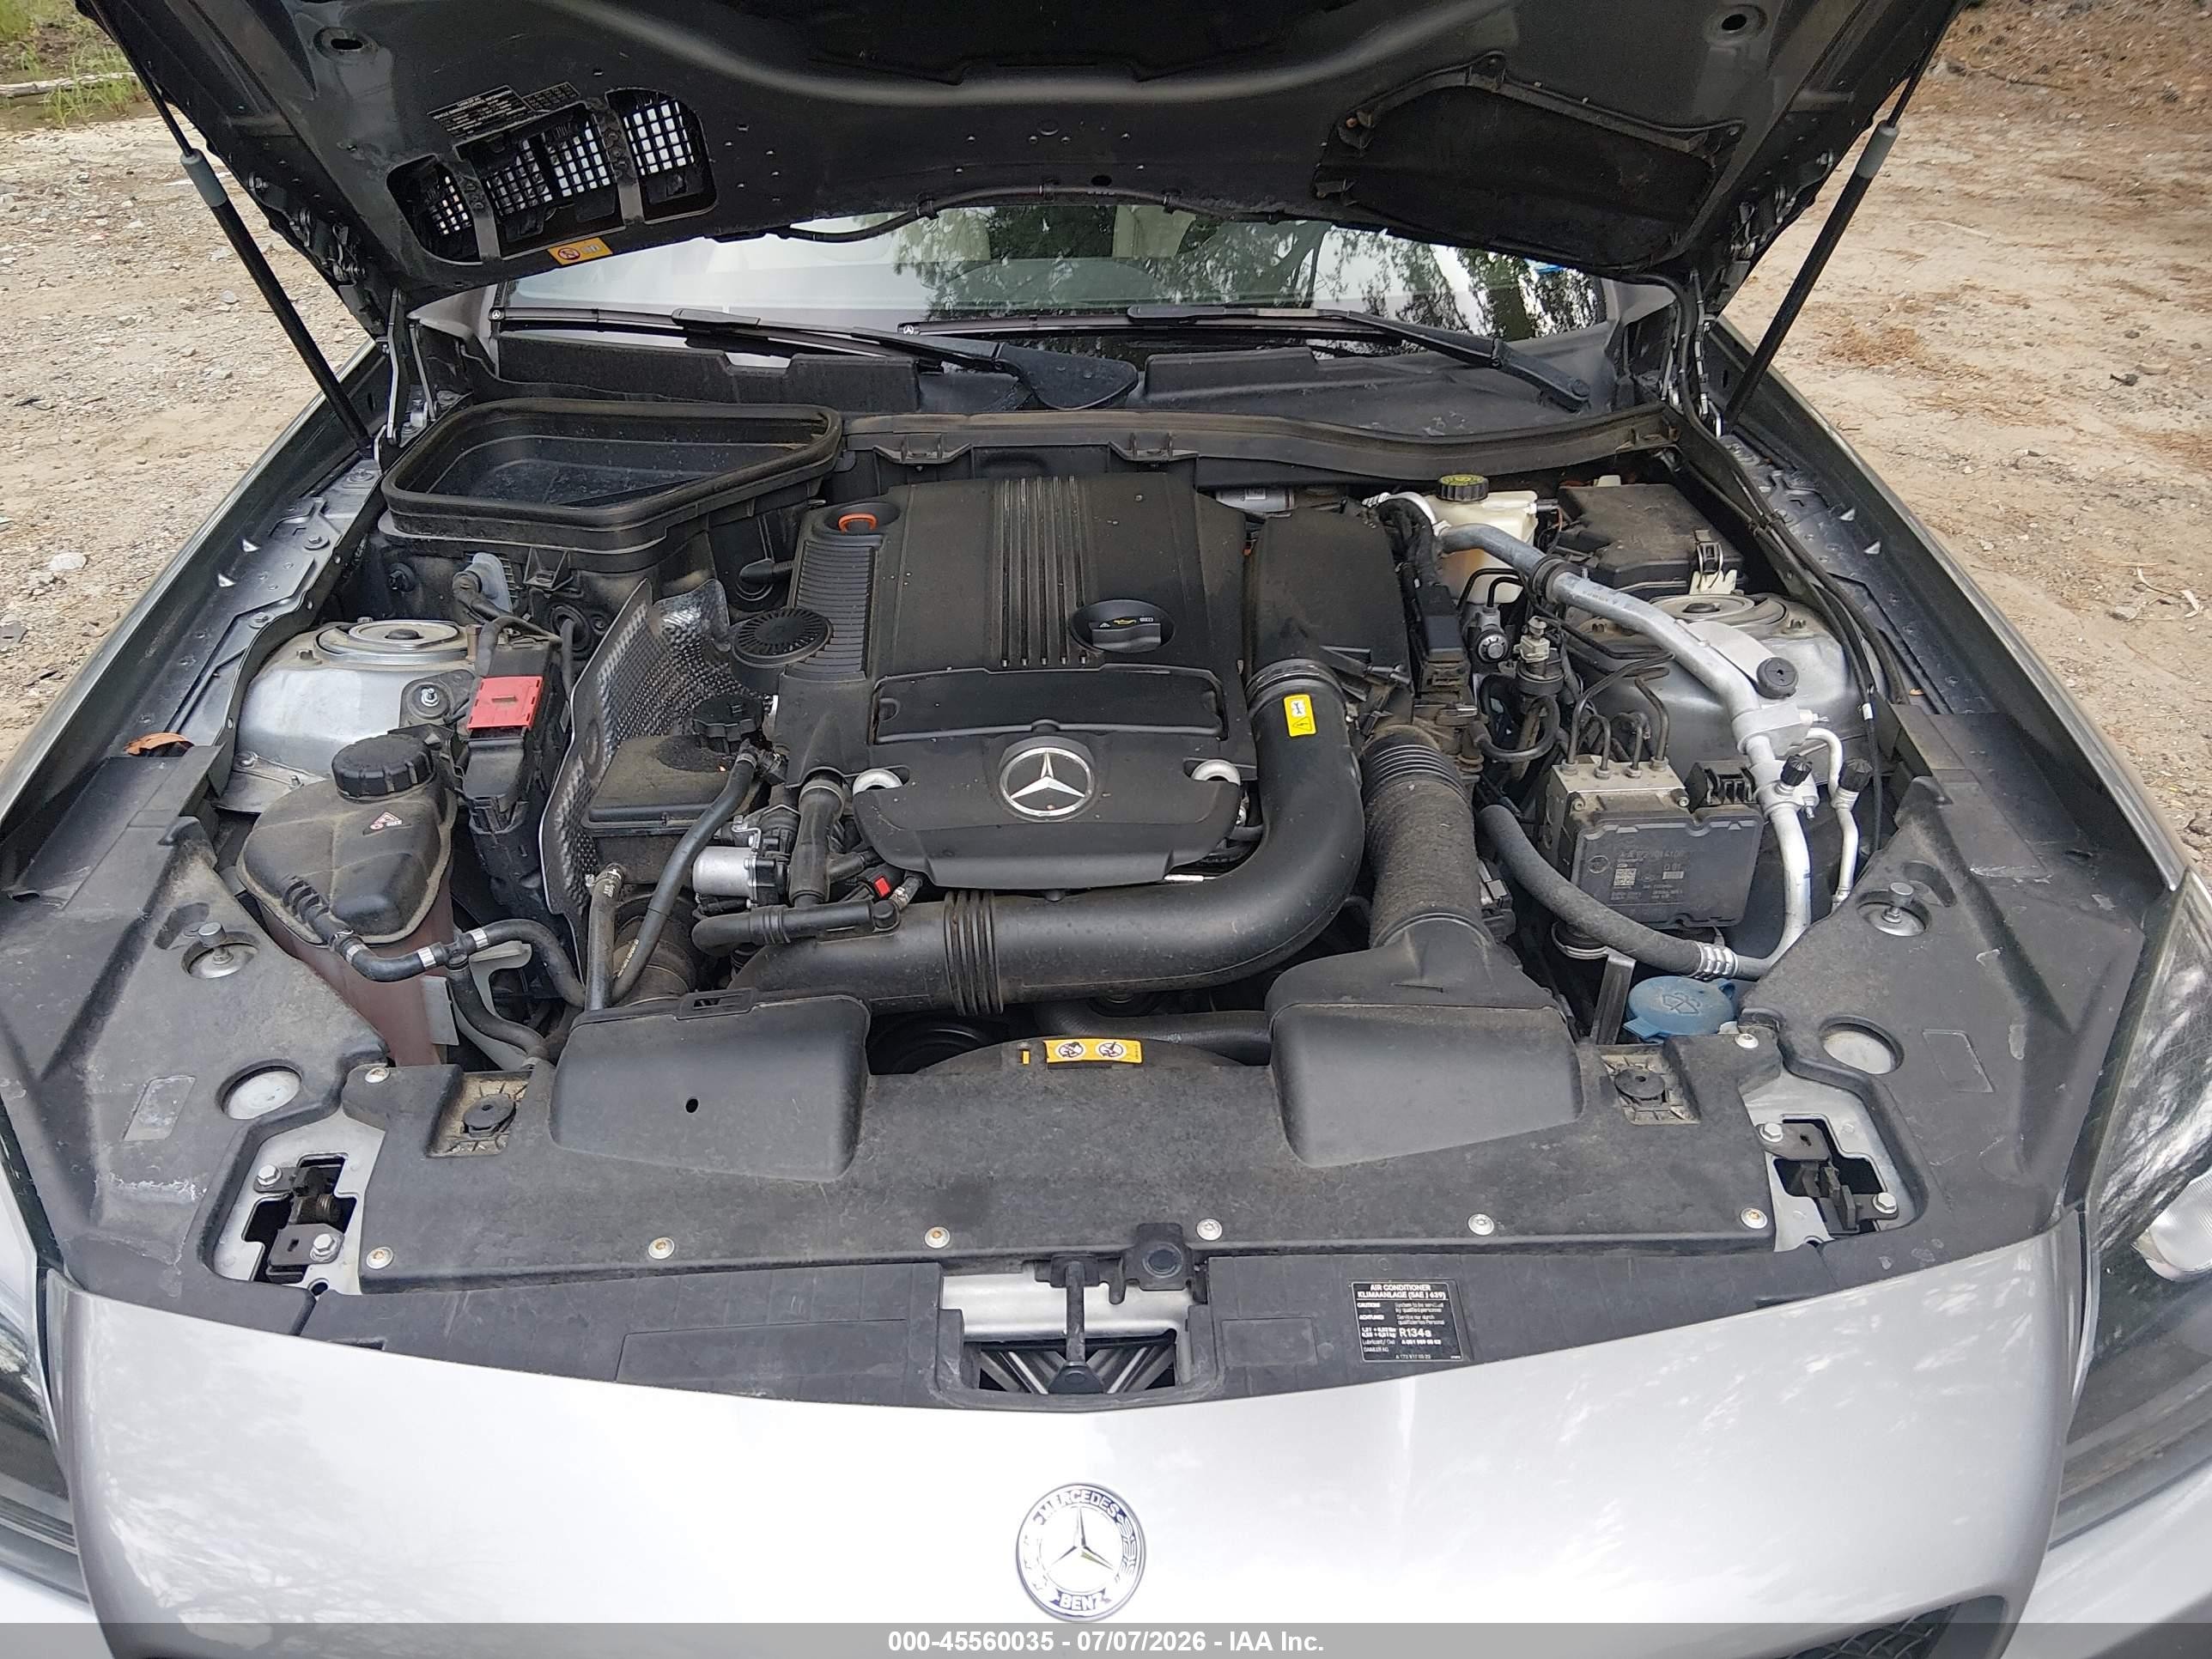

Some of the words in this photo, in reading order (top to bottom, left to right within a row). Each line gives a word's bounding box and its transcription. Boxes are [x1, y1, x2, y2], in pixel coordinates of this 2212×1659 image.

[1399, 1327, 1432, 1338] R134a
[1040, 1488, 1119, 1519] MERCEDES
[1058, 1592, 1104, 1612] BENZ
